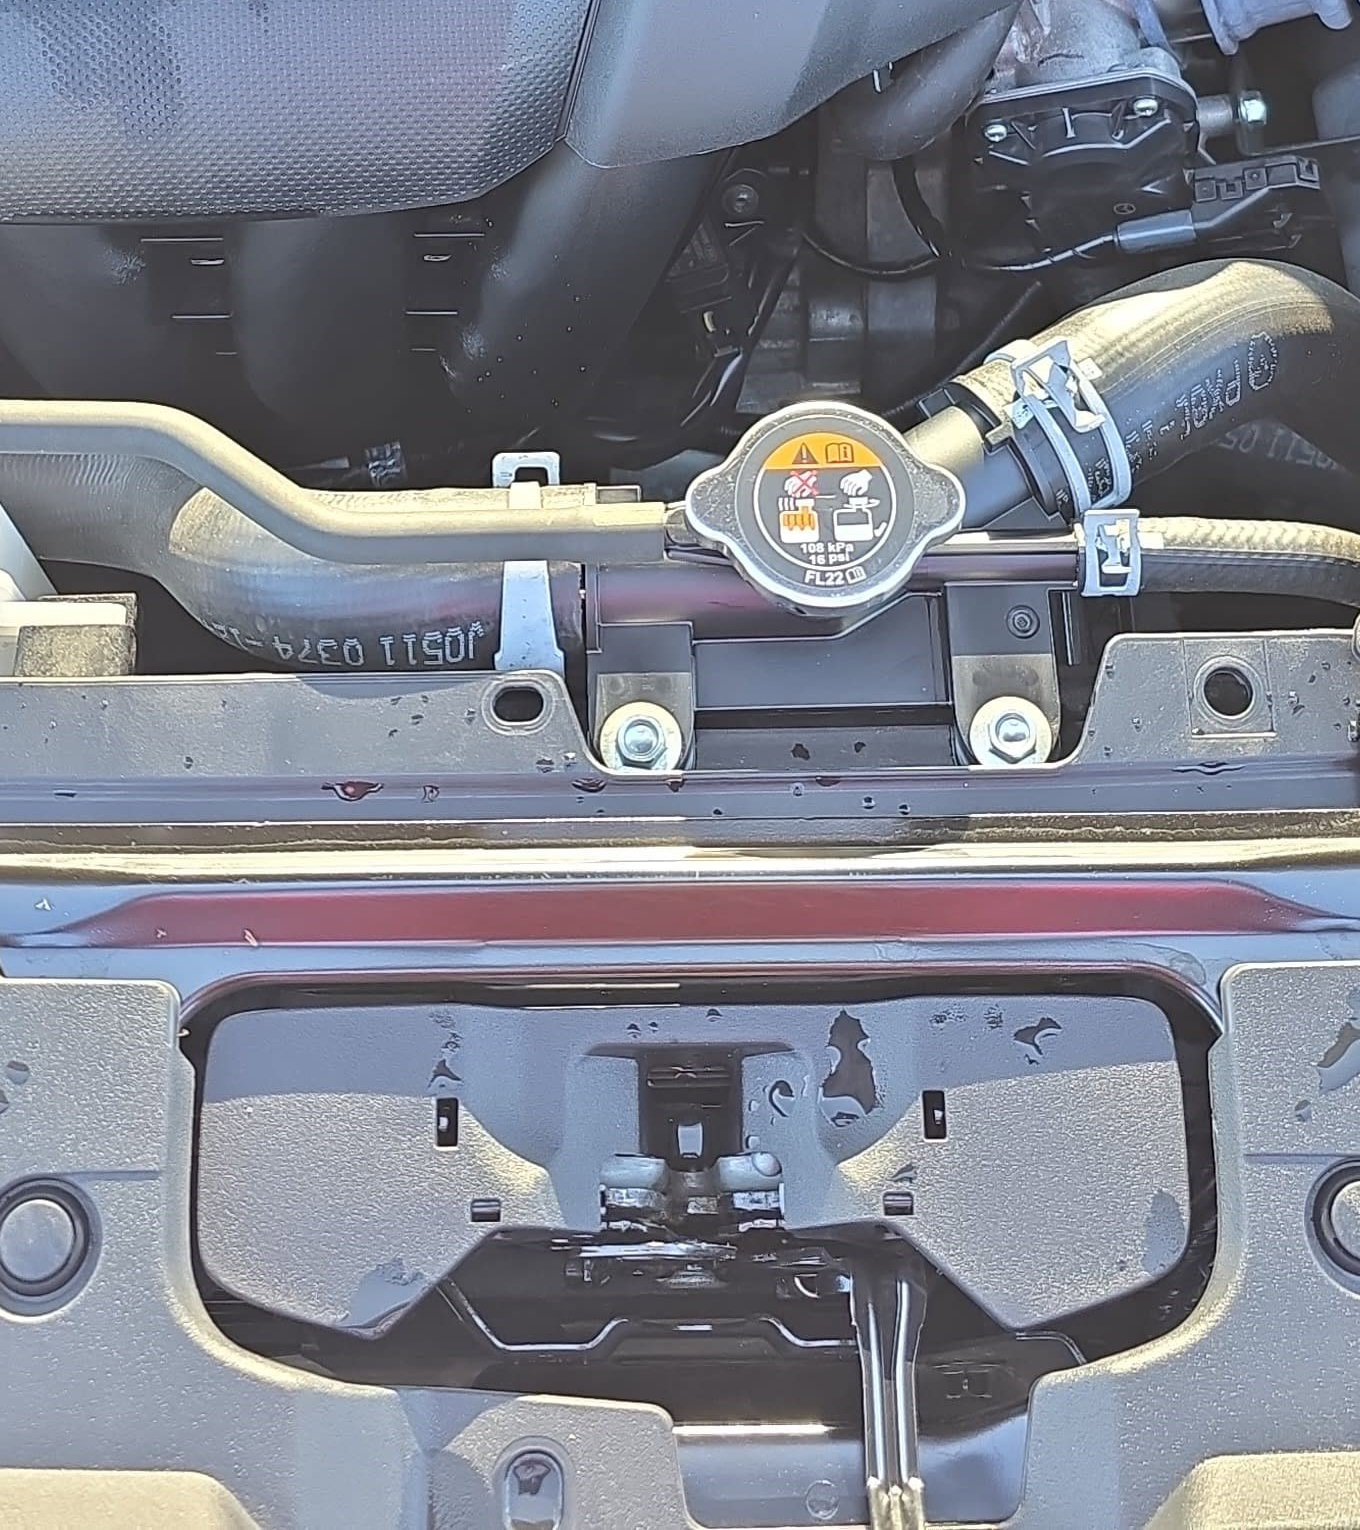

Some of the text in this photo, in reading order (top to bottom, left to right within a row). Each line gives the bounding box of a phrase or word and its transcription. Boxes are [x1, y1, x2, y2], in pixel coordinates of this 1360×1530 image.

[800, 541, 854, 554] 108 kPa
[808, 552, 850, 565] 16 psi
[804, 570, 845, 586] FL22
